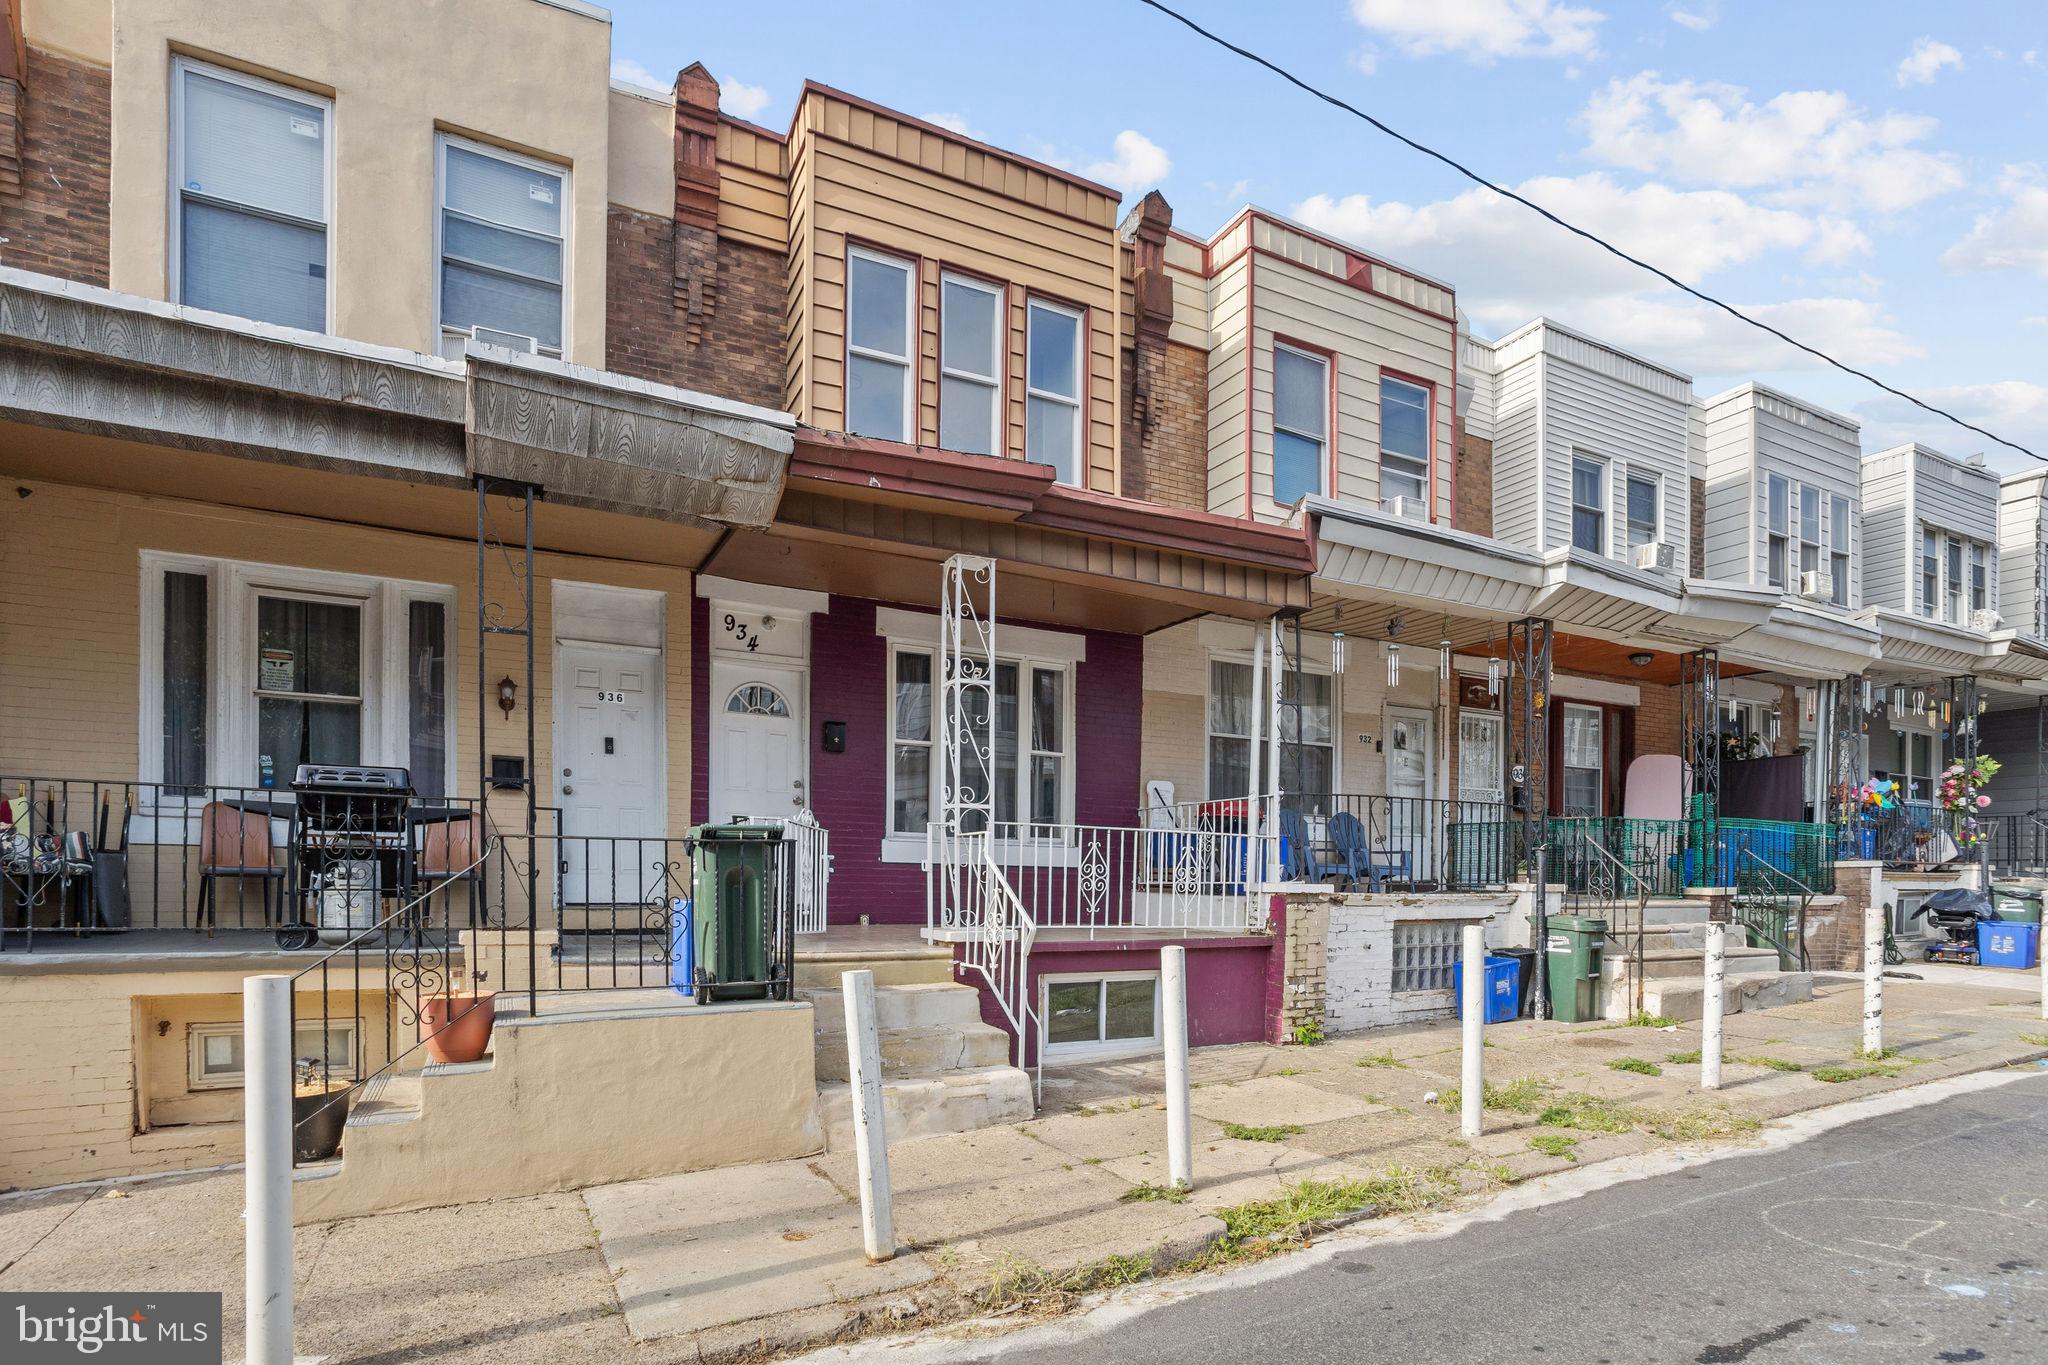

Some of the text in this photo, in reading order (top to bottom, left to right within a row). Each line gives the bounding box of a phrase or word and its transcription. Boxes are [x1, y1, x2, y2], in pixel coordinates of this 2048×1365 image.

[724, 613, 760, 652] 934
[598, 691, 623, 703] 936
[1359, 734, 1372, 744] 932
